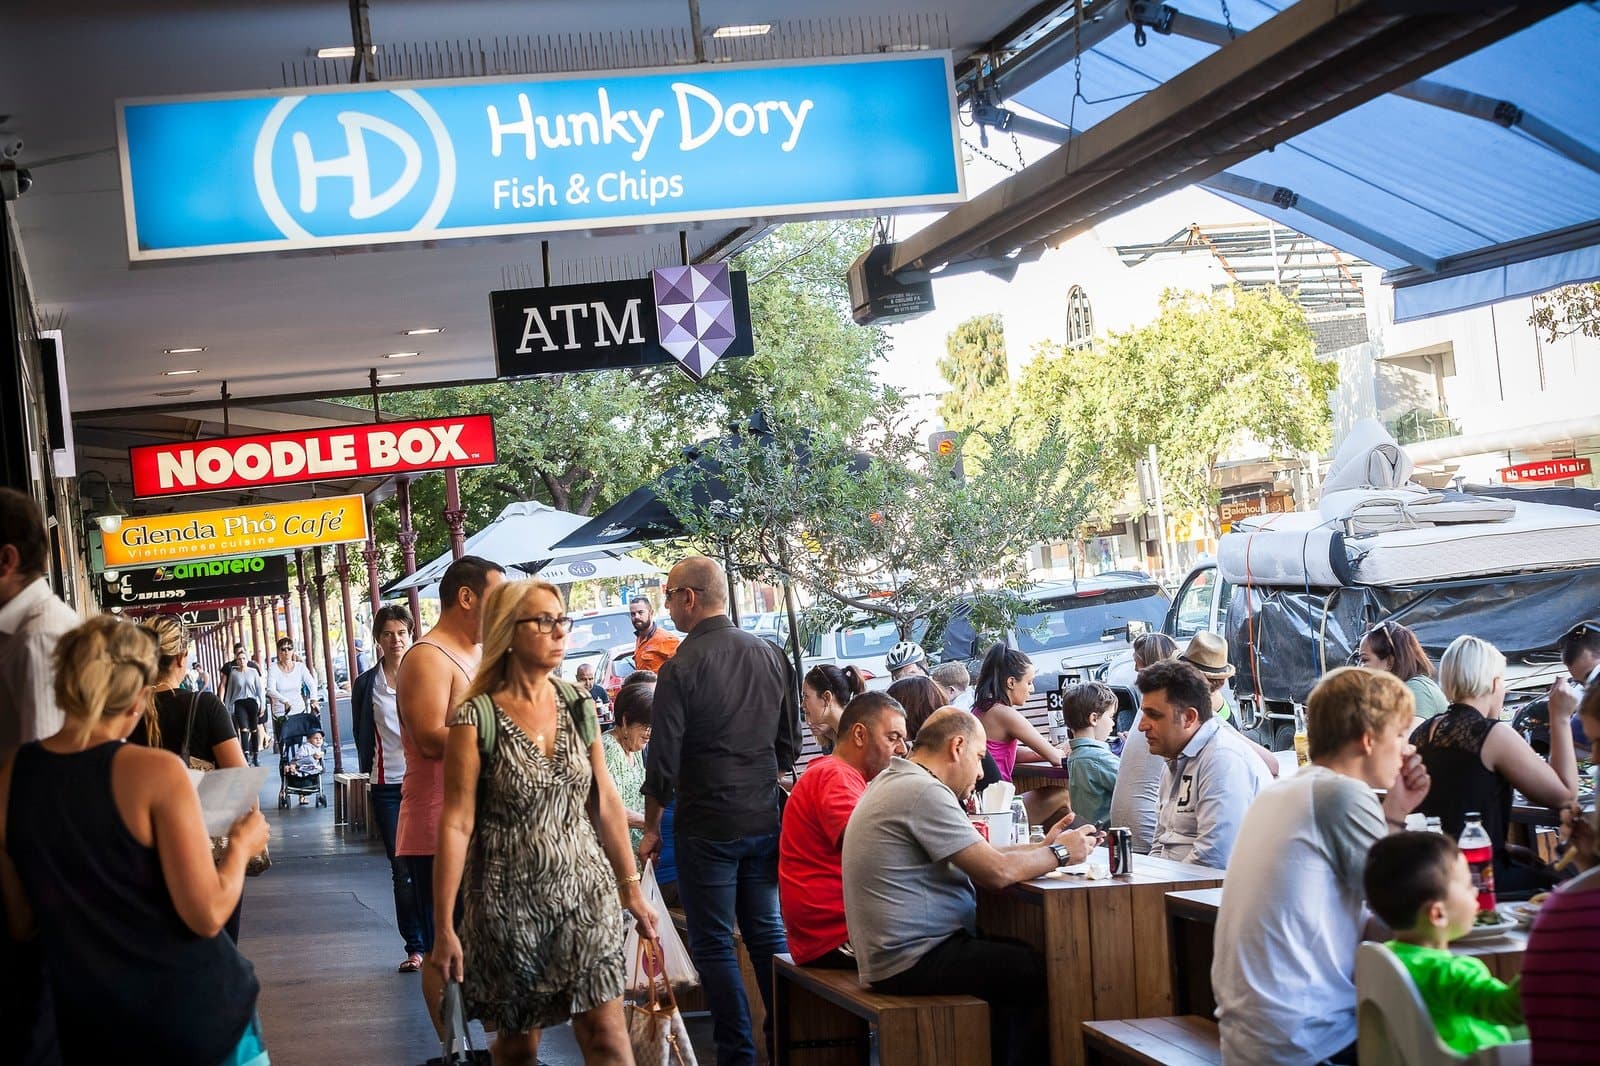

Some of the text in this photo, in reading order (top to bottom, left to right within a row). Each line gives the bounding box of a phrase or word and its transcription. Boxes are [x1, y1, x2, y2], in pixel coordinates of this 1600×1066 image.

[487, 82, 814, 161] Hunky Dory
[292, 111, 422, 219] HD
[493, 169, 684, 209] Fish & Chips
[515, 298, 646, 354] ATM
[156, 433, 357, 489] NOODLE
[367, 424, 469, 468] BOX
[1560, 462, 1586, 473] hair
[122, 520, 216, 547] Glenda
[283, 508, 345, 538] Café
[128, 537, 276, 559] Vietnamese cuisine
